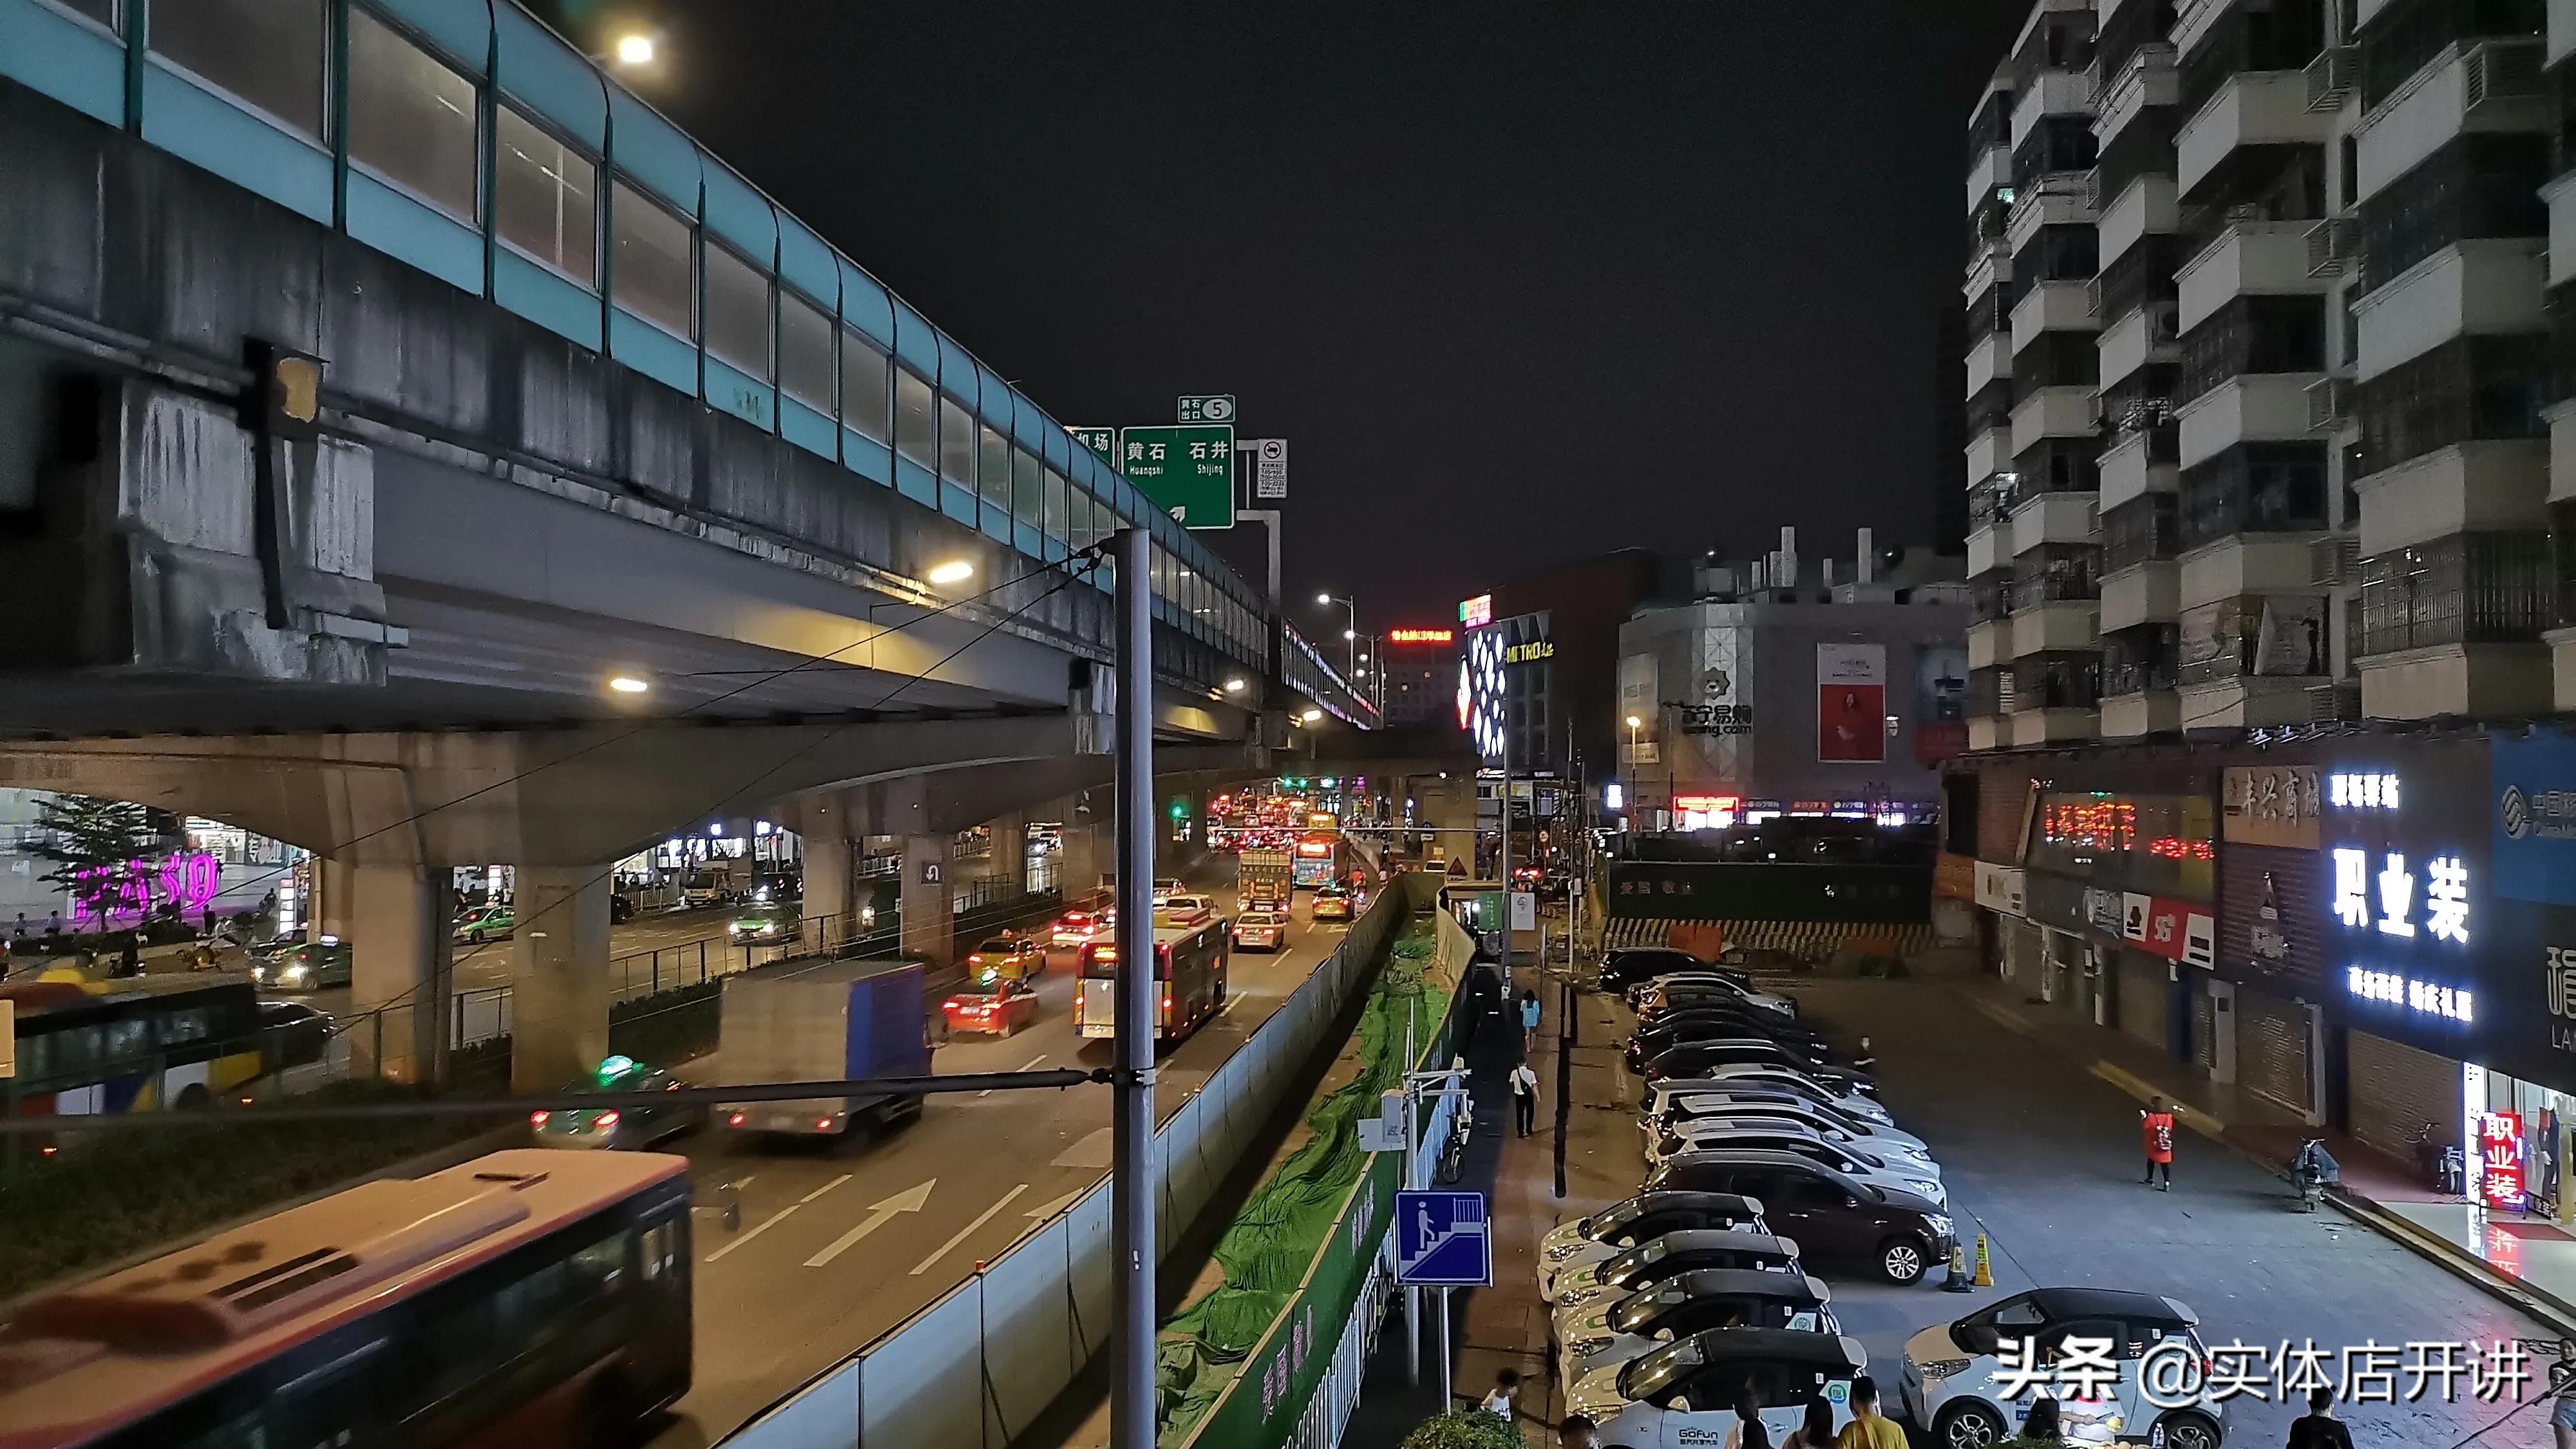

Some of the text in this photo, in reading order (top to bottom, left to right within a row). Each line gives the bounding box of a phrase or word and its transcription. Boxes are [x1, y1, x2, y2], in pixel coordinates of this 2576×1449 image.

[1181, 399, 1201, 409] 黄石
[1212, 402, 1223, 418] 5
[1181, 411, 1200, 420] 出口
[1127, 441, 1229, 460] 黄石 石井
[1130, 464, 1223, 476] Huangshi Shijing
[2333, 848, 2469, 944] 职业装
[2483, 1116, 2519, 1198] 职业装
[1679, 1429, 1718, 1439] GoFun
